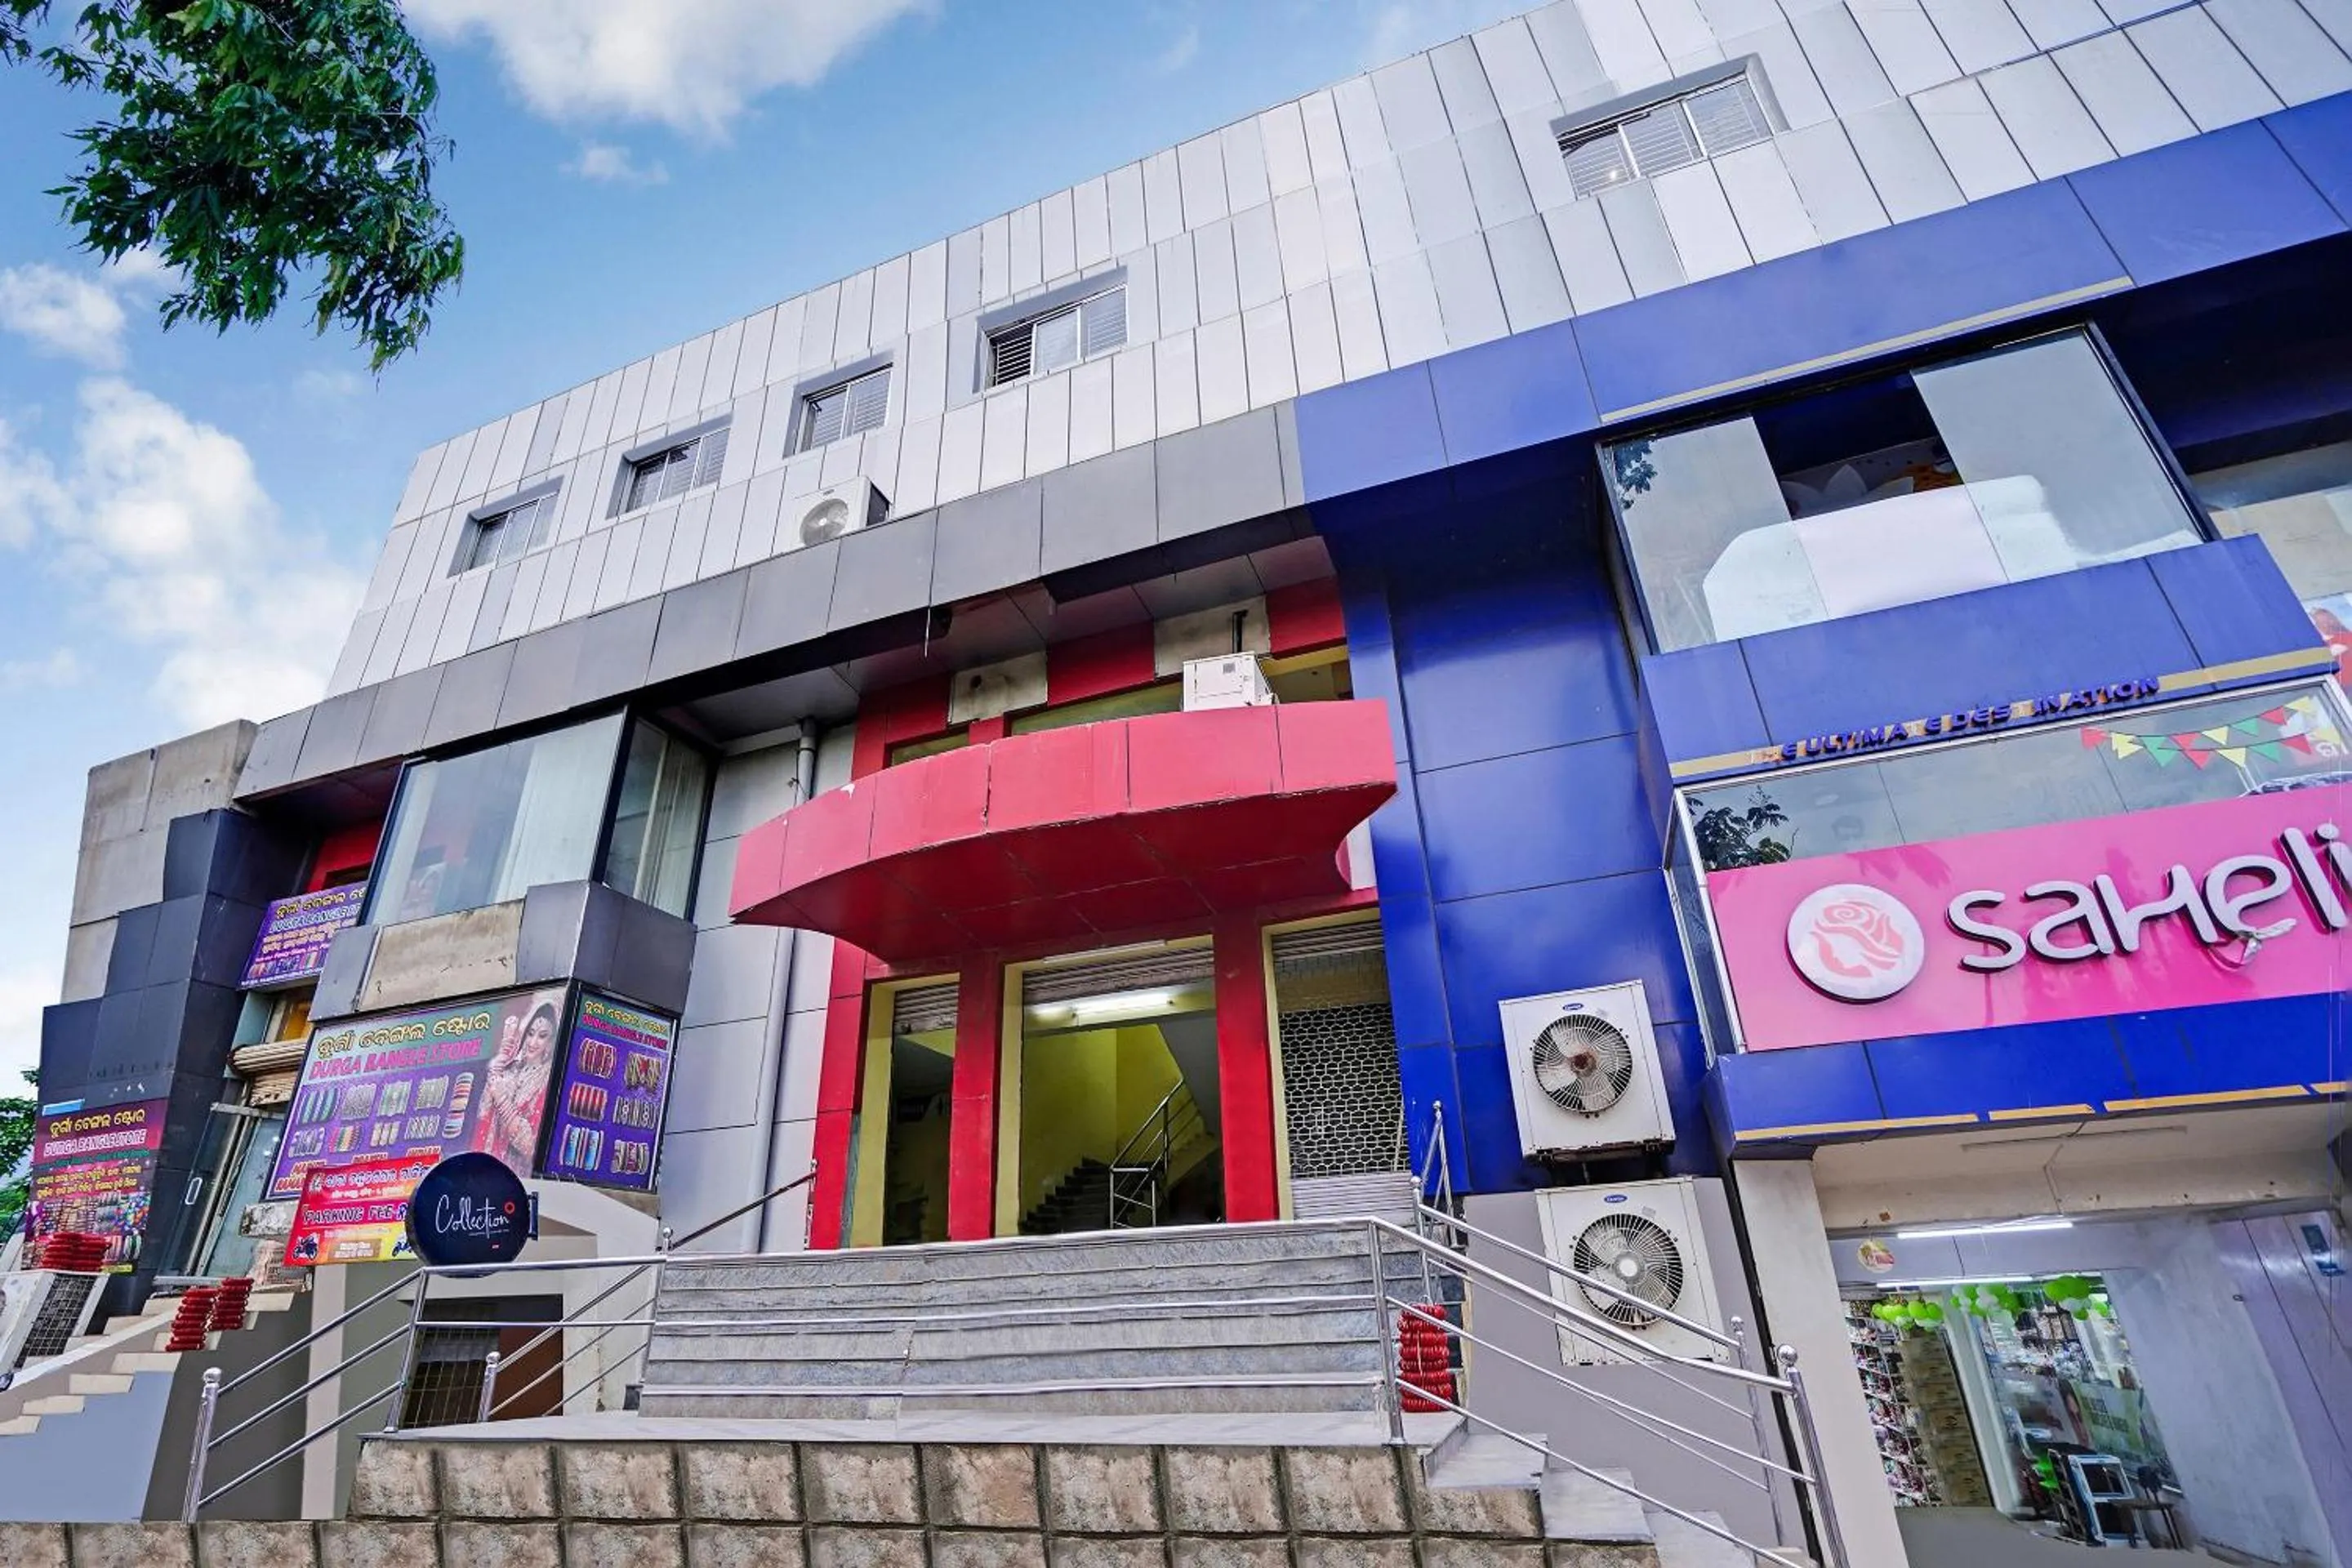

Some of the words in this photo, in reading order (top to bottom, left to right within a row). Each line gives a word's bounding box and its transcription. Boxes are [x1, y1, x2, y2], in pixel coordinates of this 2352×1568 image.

[310, 1054, 361, 1080] DURGA
[363, 1047, 427, 1072] BANGLE
[431, 1038, 483, 1062] STORE
[303, 1206, 364, 1225] PARKING
[435, 1194, 510, 1240] Collection
